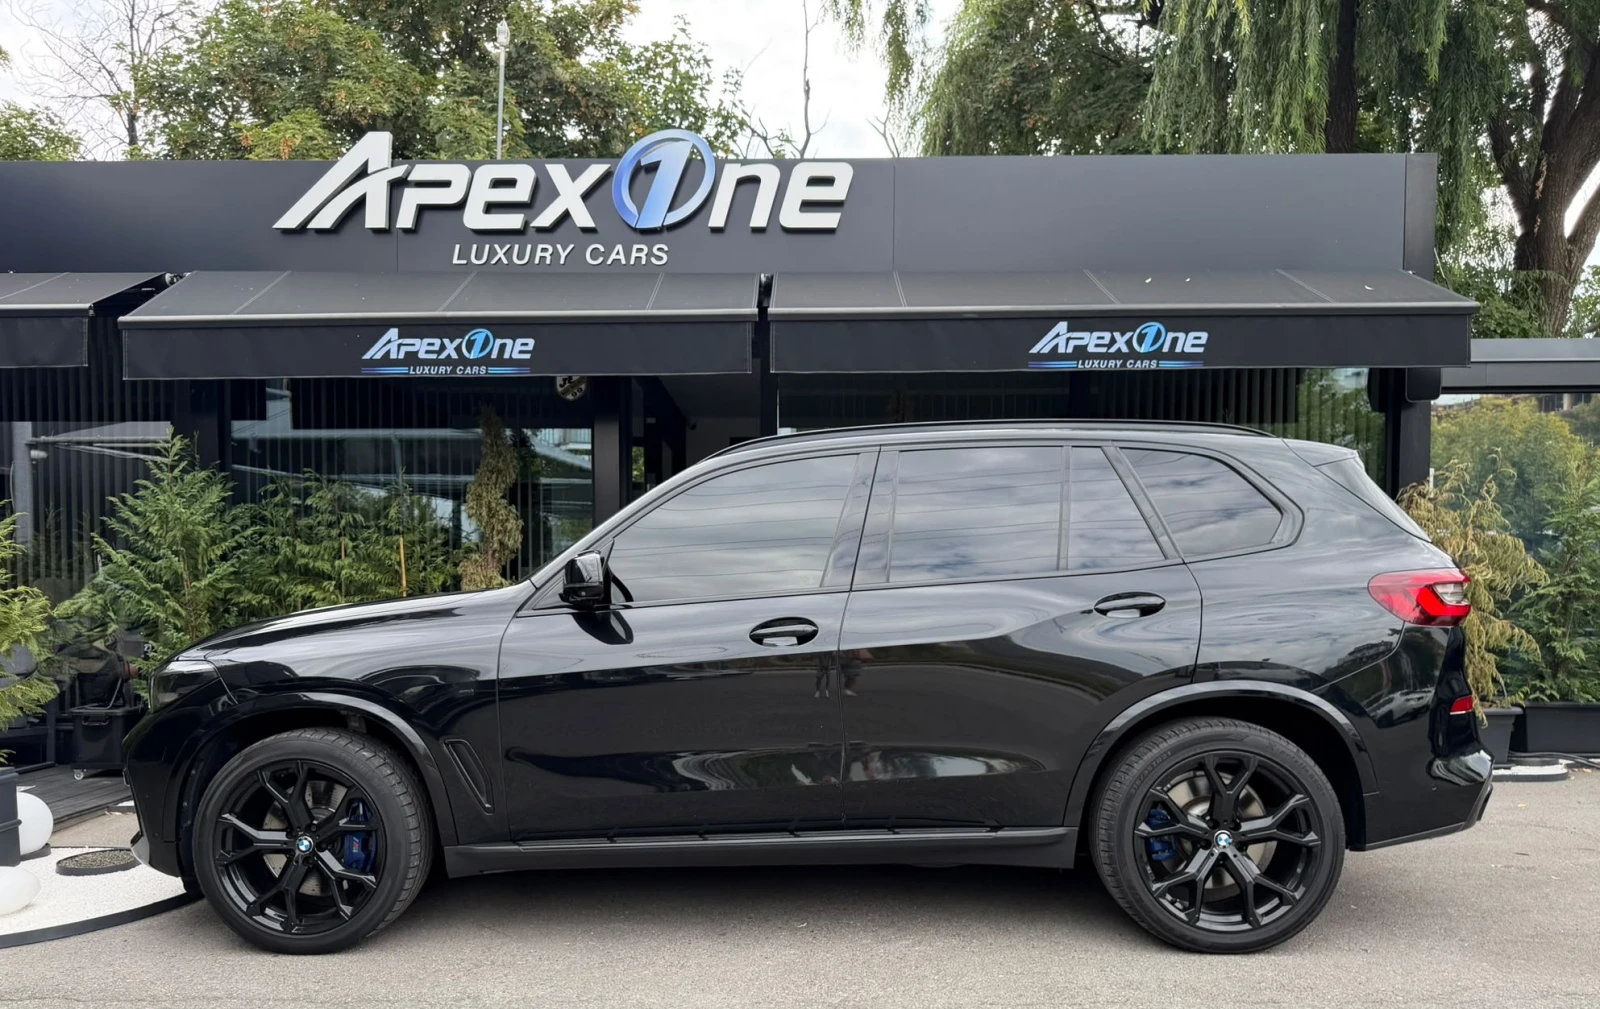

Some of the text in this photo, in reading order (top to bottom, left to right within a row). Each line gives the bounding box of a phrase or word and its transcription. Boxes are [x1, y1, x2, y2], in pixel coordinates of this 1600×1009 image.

[452, 243, 669, 265] LUXURY CARS
[1078, 360, 1157, 369] LUXURY CARS
[409, 366, 487, 375] LUXURY CARS
